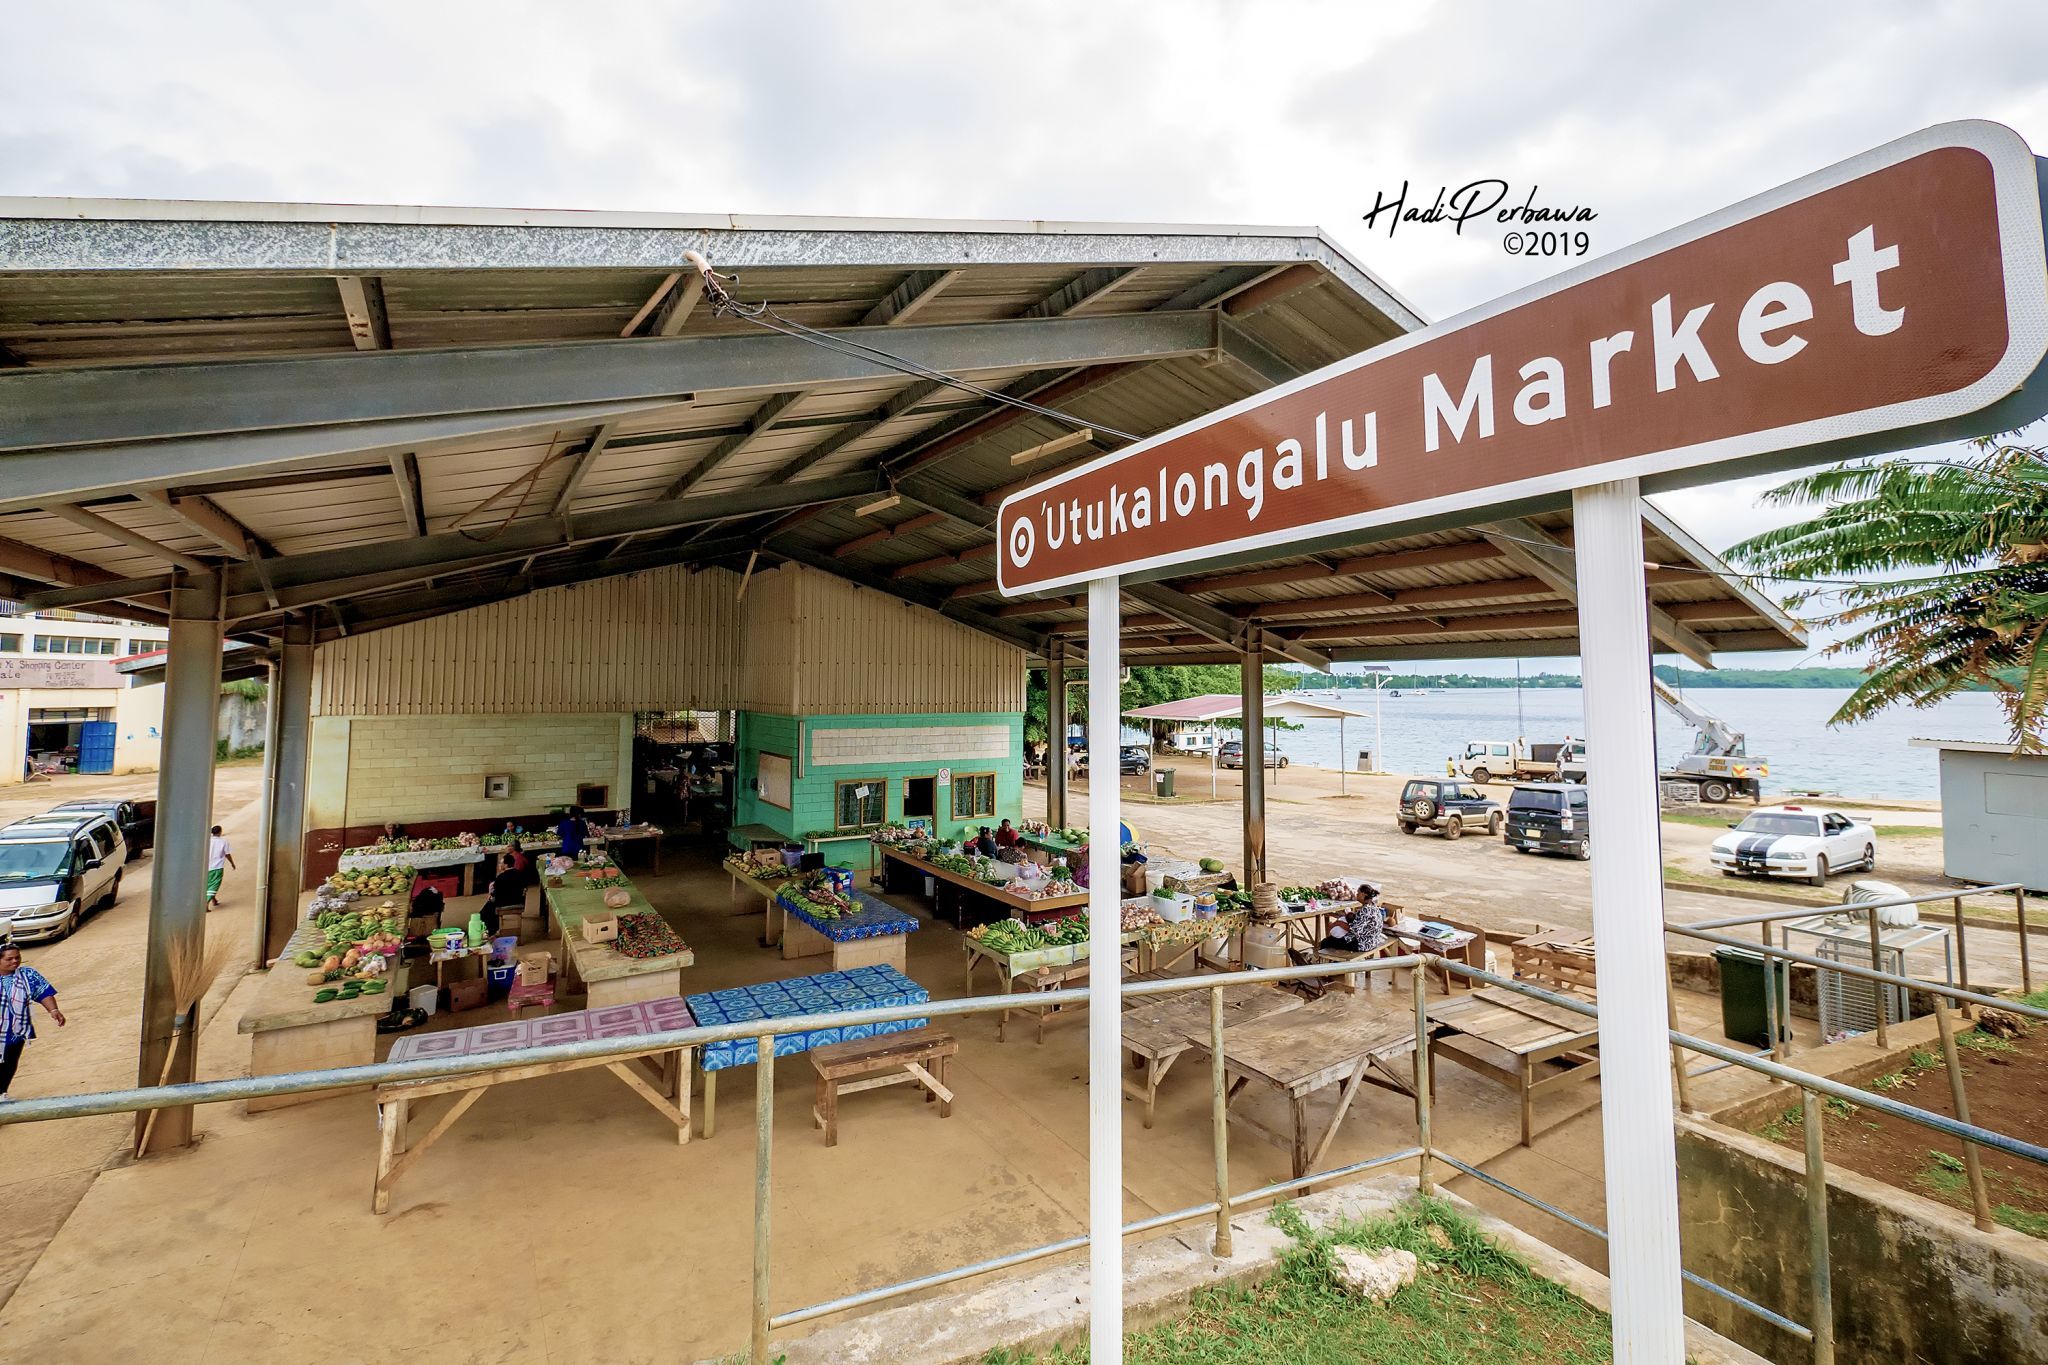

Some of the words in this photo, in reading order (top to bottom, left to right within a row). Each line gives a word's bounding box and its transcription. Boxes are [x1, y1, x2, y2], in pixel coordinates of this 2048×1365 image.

[1421, 224, 1905, 454] Market
[20, 660, 51, 672] Shopping
[54, 661, 86, 670] Center
